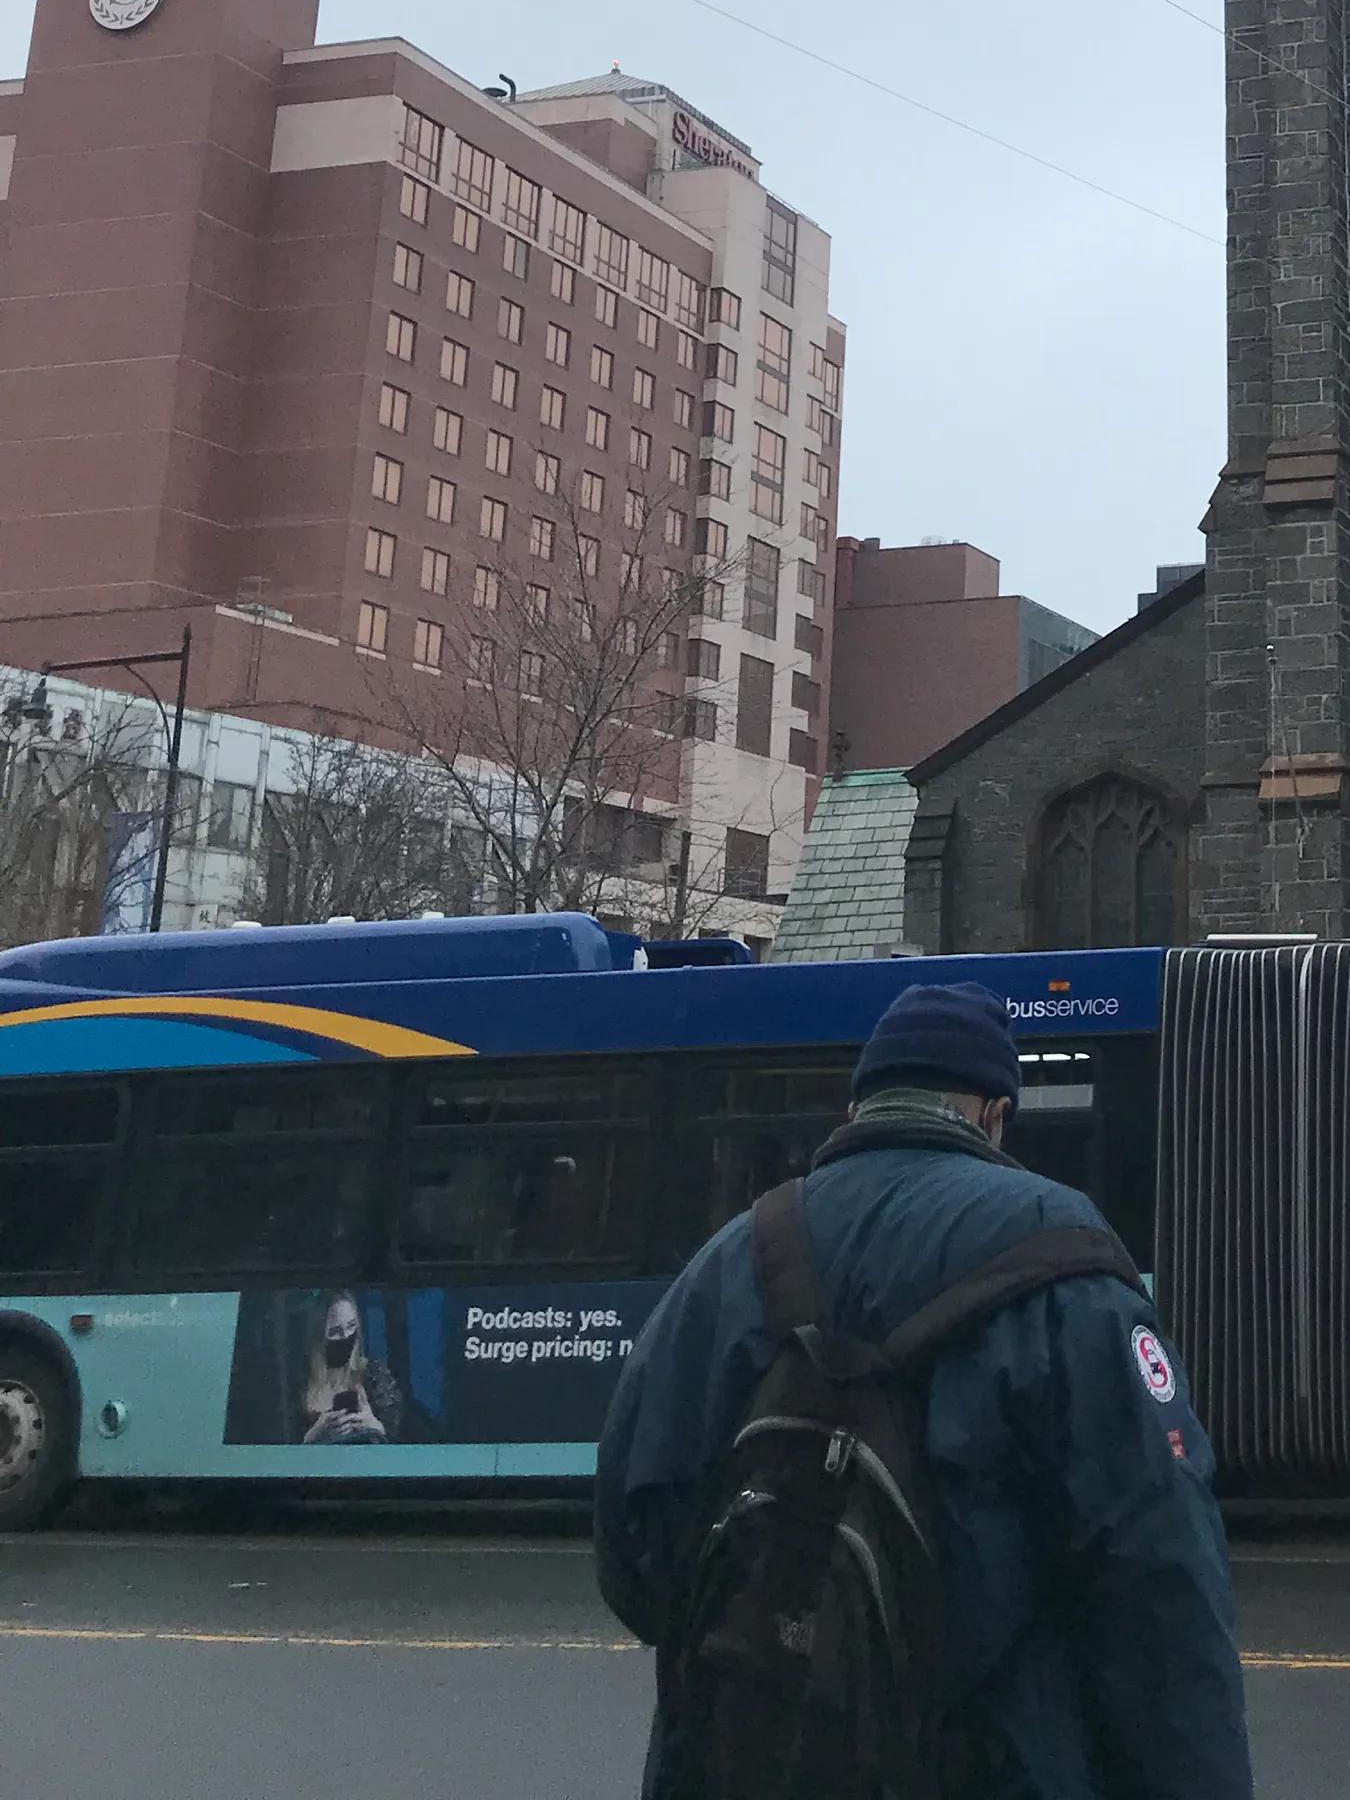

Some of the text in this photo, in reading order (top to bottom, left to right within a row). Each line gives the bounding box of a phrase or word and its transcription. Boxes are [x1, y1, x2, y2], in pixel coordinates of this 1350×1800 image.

[467, 1306, 623, 1332] Podcasts: yes.
[464, 1335, 634, 1363] Surge pricing: n
